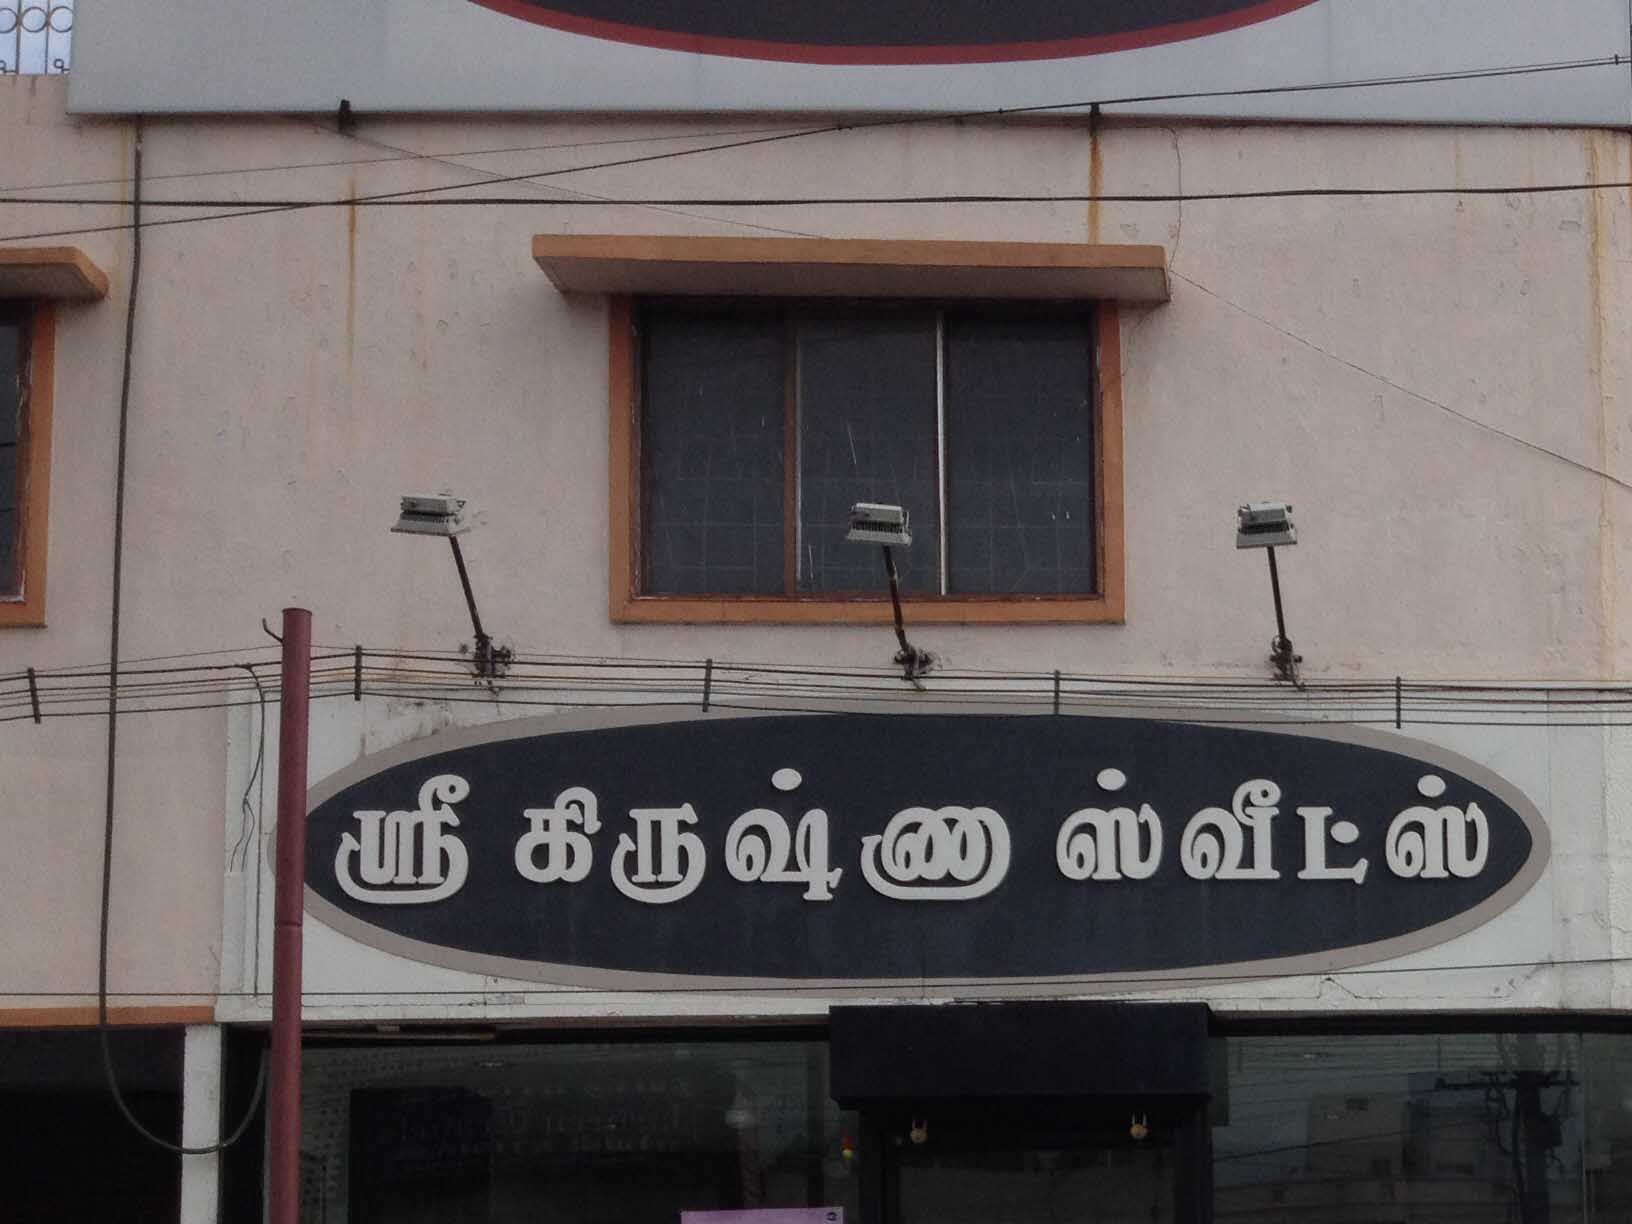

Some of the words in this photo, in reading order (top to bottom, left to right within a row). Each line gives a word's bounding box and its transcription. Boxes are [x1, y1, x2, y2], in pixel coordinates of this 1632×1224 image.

[333, 772, 471, 906] ஸ்ரீ
[513, 766, 1012, 904] கிருஷ்ண
[1054, 766, 1495, 886] ஸ்வீட்ஸ்
